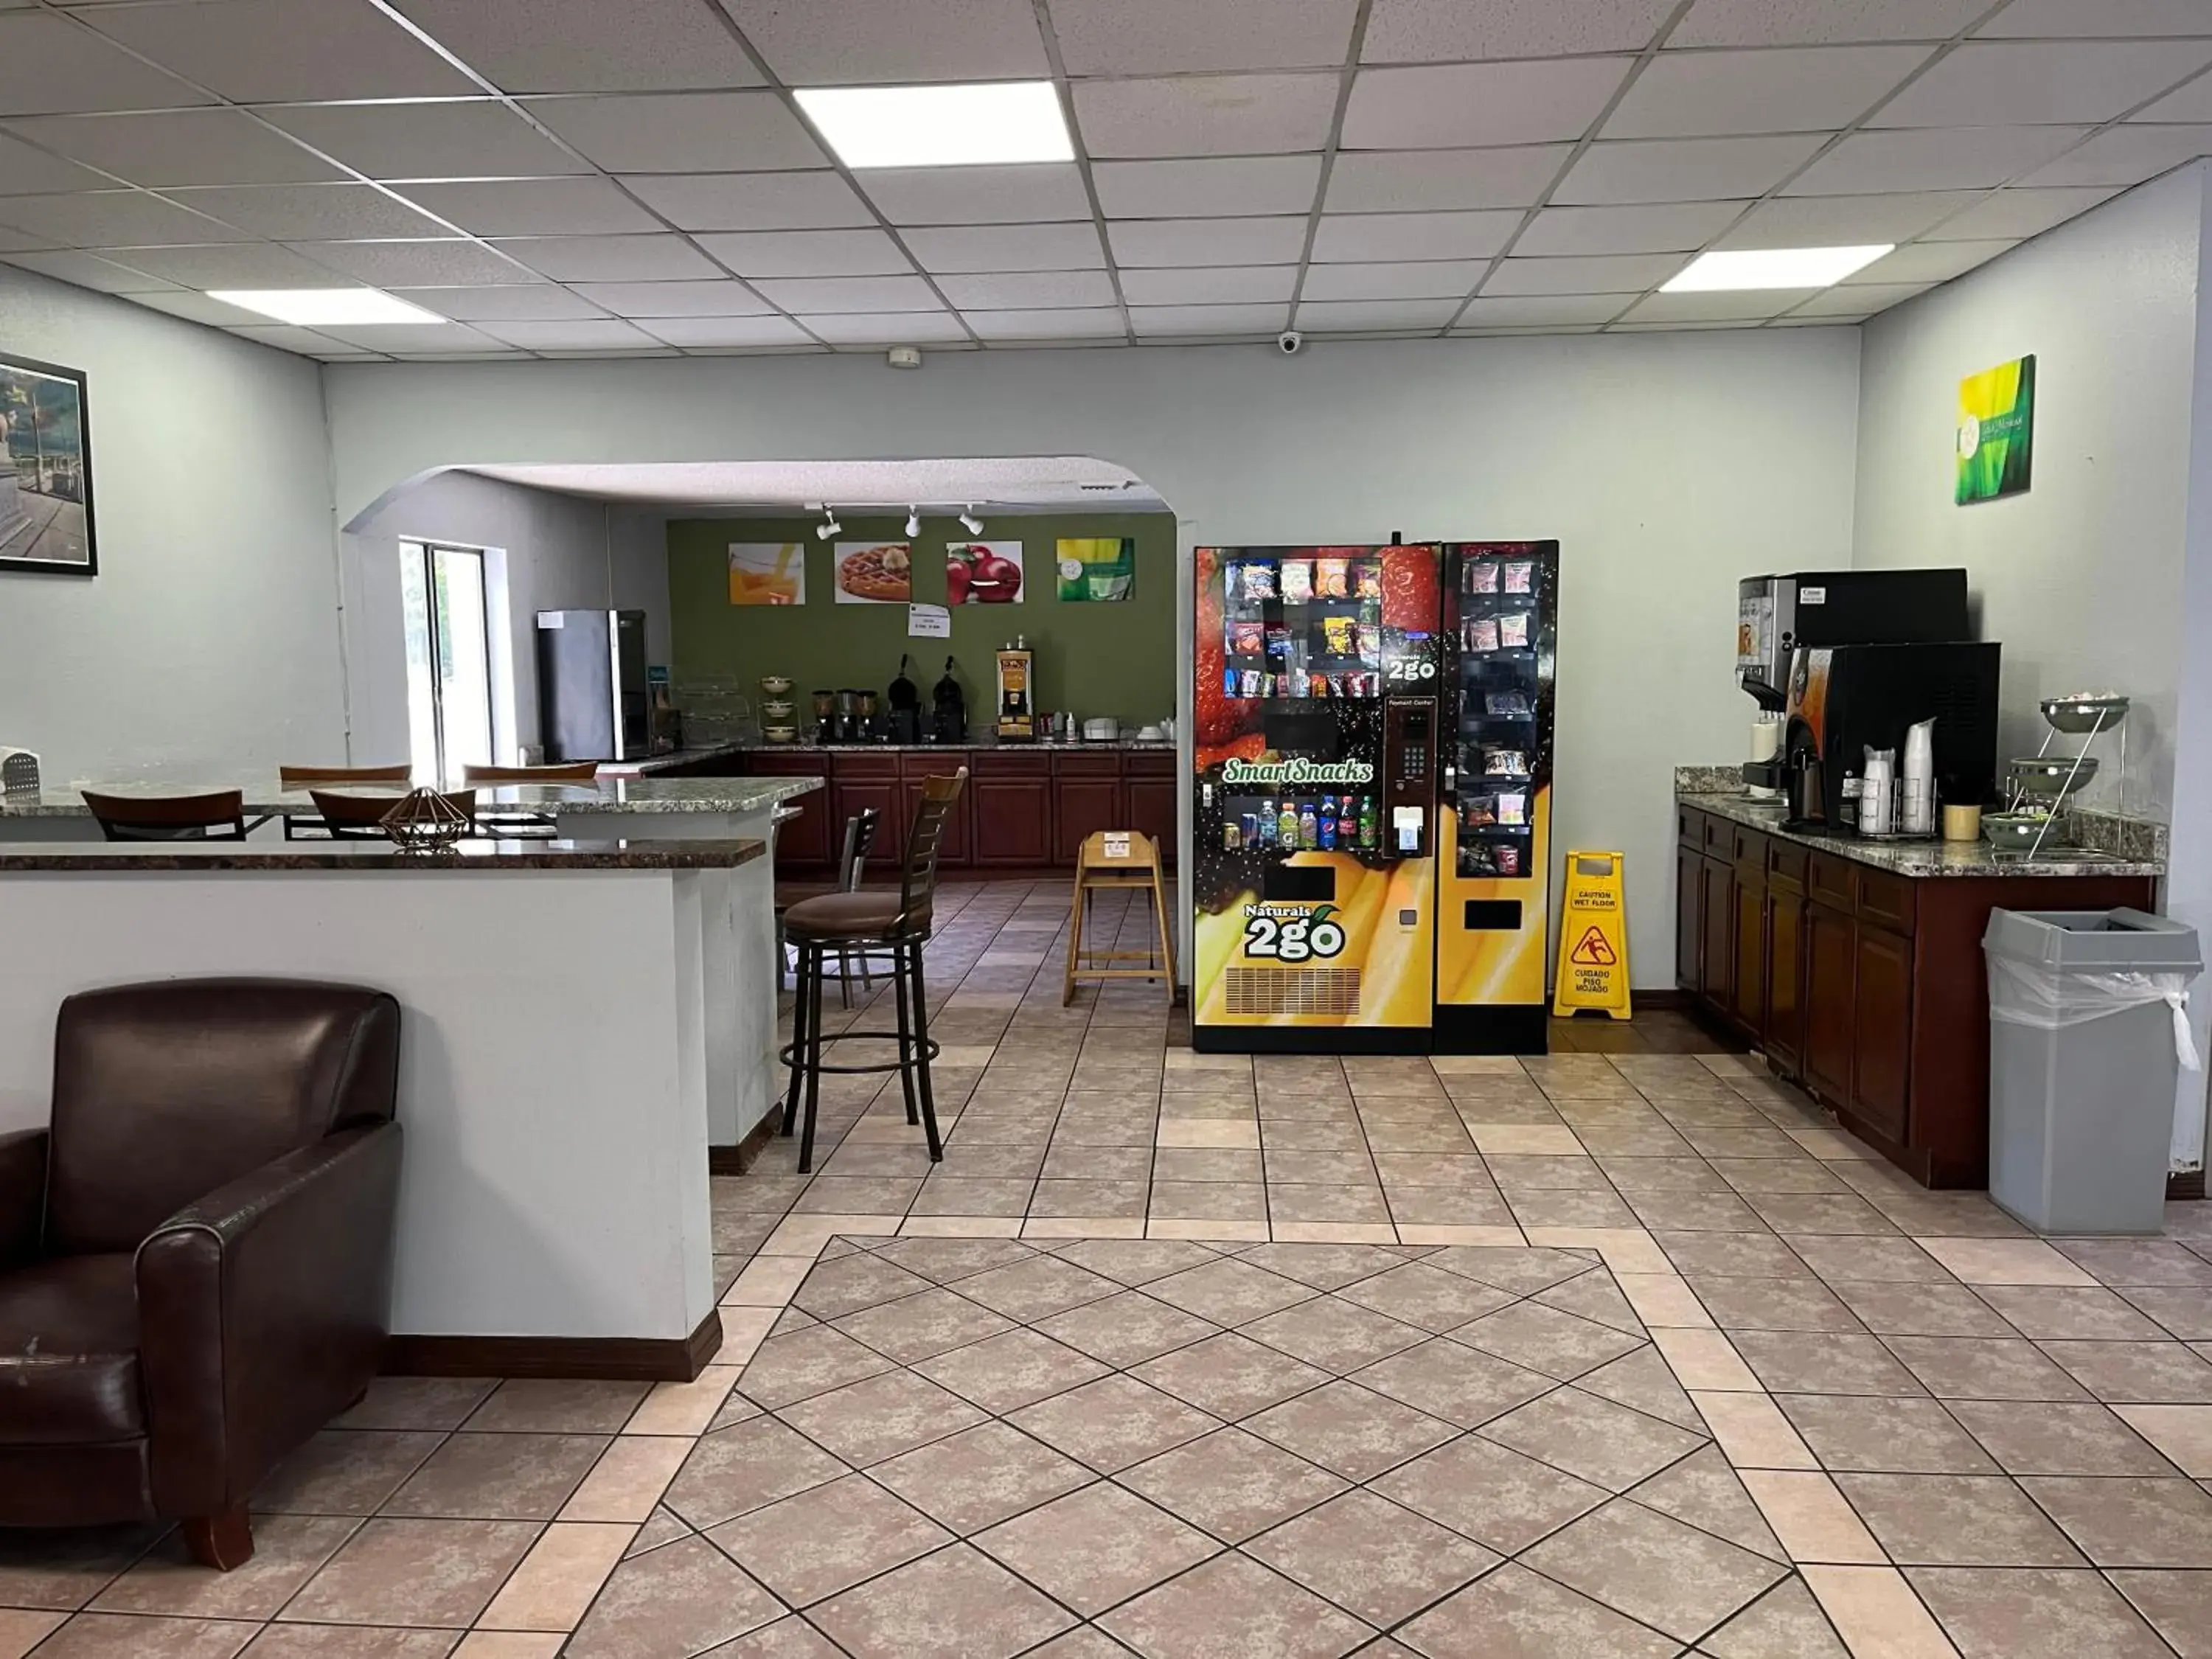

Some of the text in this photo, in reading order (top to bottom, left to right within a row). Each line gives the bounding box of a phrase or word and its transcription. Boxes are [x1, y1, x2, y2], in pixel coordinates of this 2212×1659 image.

[1388, 661, 1435, 681] 2go
[1222, 758, 1374, 783] SmartSnacks
[1579, 891, 1611, 899] CAUTION
[1245, 904, 1312, 917] Naturals
[1247, 917, 1343, 960] 2go
[1575, 970, 1610, 978] CUIDADO
[1576, 985, 1608, 993] MOJADO
